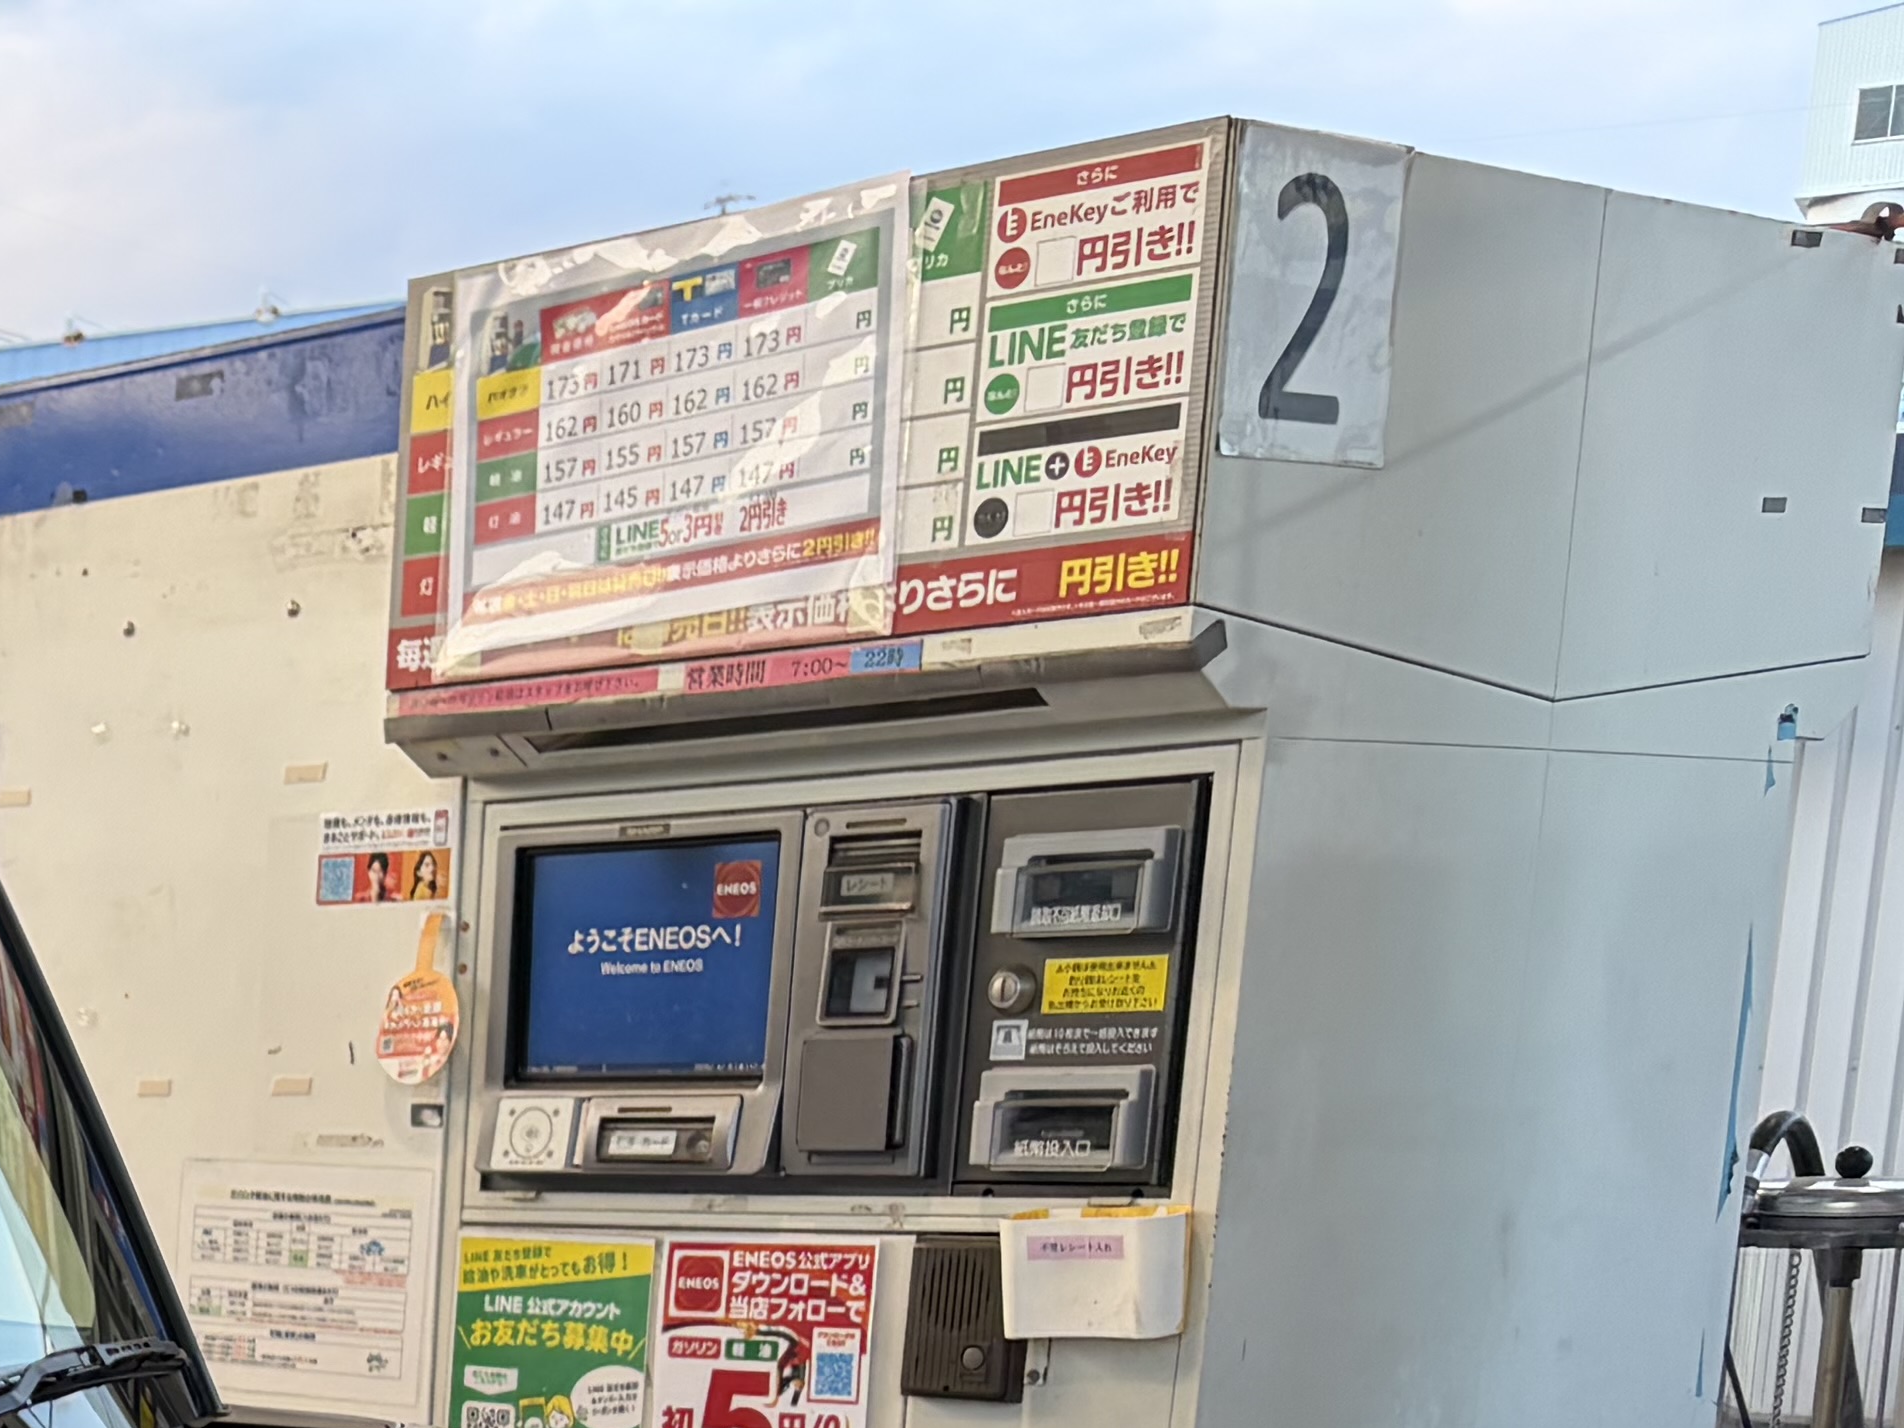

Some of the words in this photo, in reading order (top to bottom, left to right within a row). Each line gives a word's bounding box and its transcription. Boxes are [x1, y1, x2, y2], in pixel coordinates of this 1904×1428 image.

[1077, 165, 1119, 185] さらに
[1076, 220, 1196, 276] 円引き!!
[1066, 294, 1107, 314] さらに
[1258, 172, 1349, 425] 2
[989, 323, 1068, 368] LINE
[1071, 313, 1187, 349] 友だち登録で
[1065, 350, 1185, 403] 円引き!!
[976, 454, 1043, 490] LINE
[1105, 443, 1179, 469] EneKey
[1054, 477, 1173, 529] 円引き!!
[686, 659, 767, 691] 営業時間
[715, 880, 758, 897] ENEOS
[600, 959, 648, 976] Welcome
[650, 960, 662, 974] to
[663, 958, 704, 974] ENEOS
[677, 1275, 720, 1291] ENEOS
[483, 1293, 524, 1315] LINE
[729, 1295, 866, 1324] 当店フォローで
[671, 1339, 720, 1357] ガソリン
